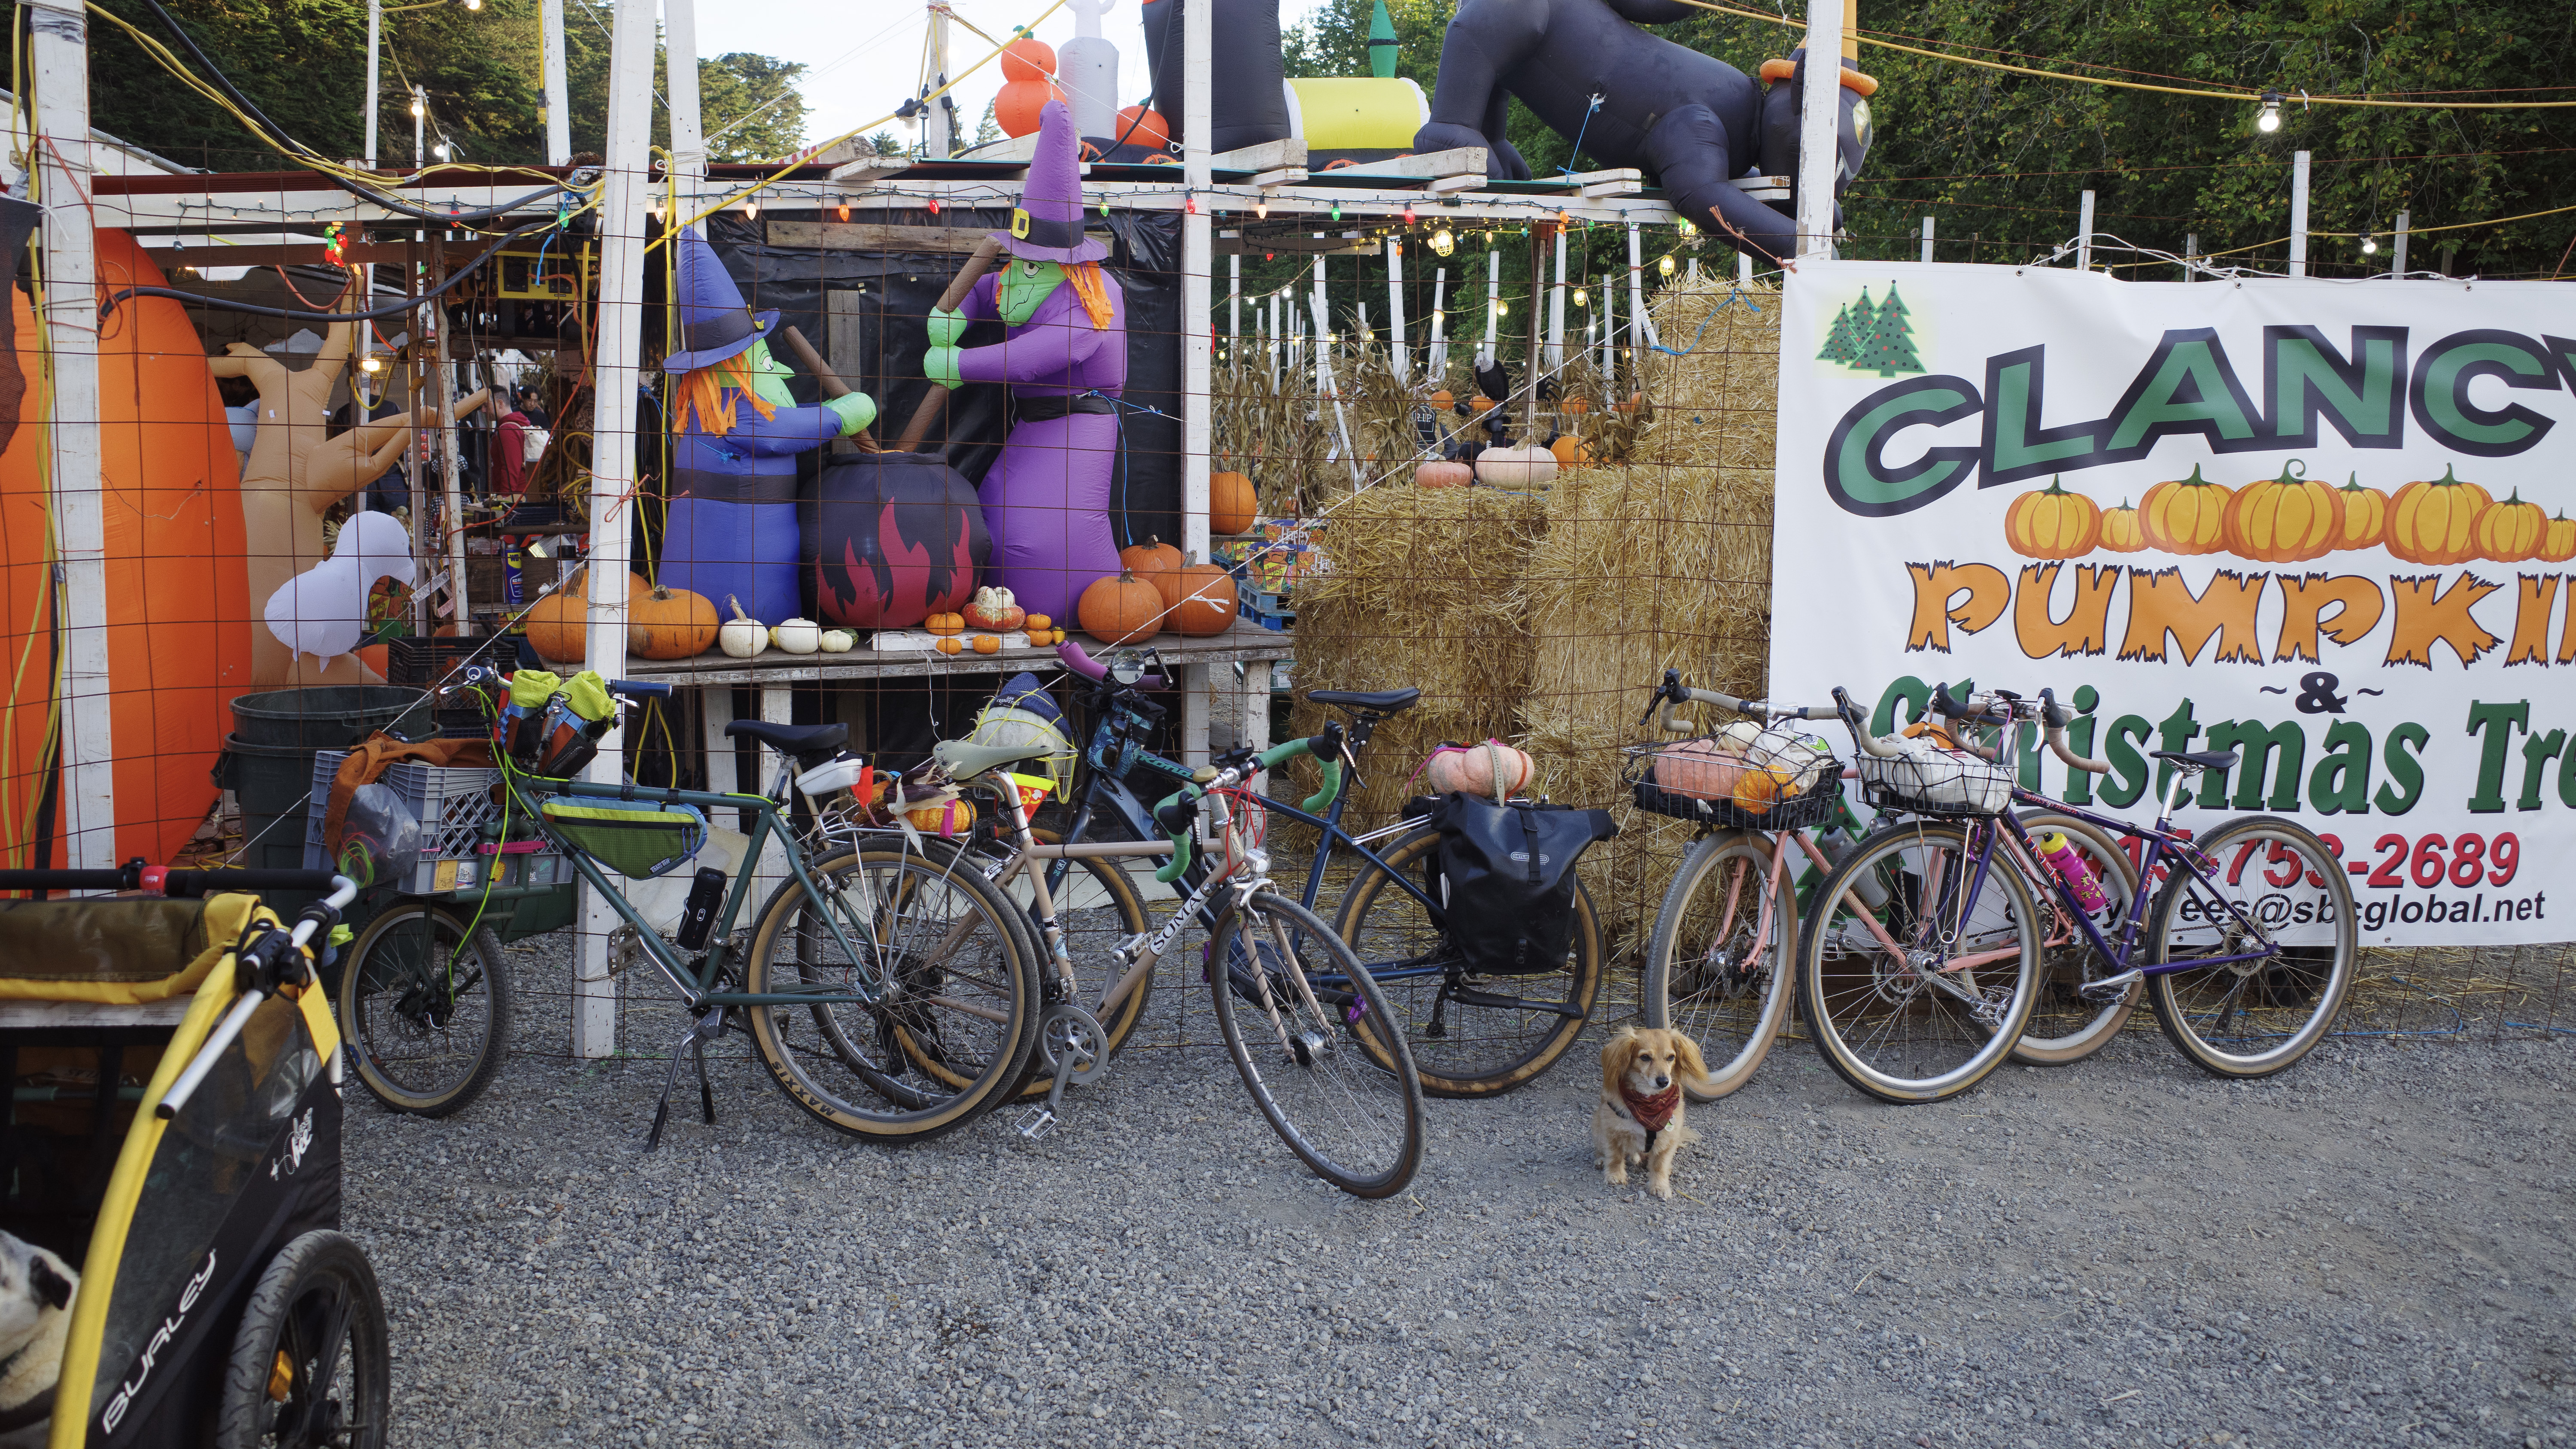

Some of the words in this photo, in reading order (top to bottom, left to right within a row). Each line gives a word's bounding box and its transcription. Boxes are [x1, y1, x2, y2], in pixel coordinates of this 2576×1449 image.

[1267, 565, 1282, 575] Watch
[1268, 579, 1278, 589] Step
[1905, 559, 2576, 670] PUMPKI
[1154, 896, 1203, 951] SOMA
[771, 1061, 837, 1117] MAXXIS
[102, 1249, 216, 1434] BURLEY
